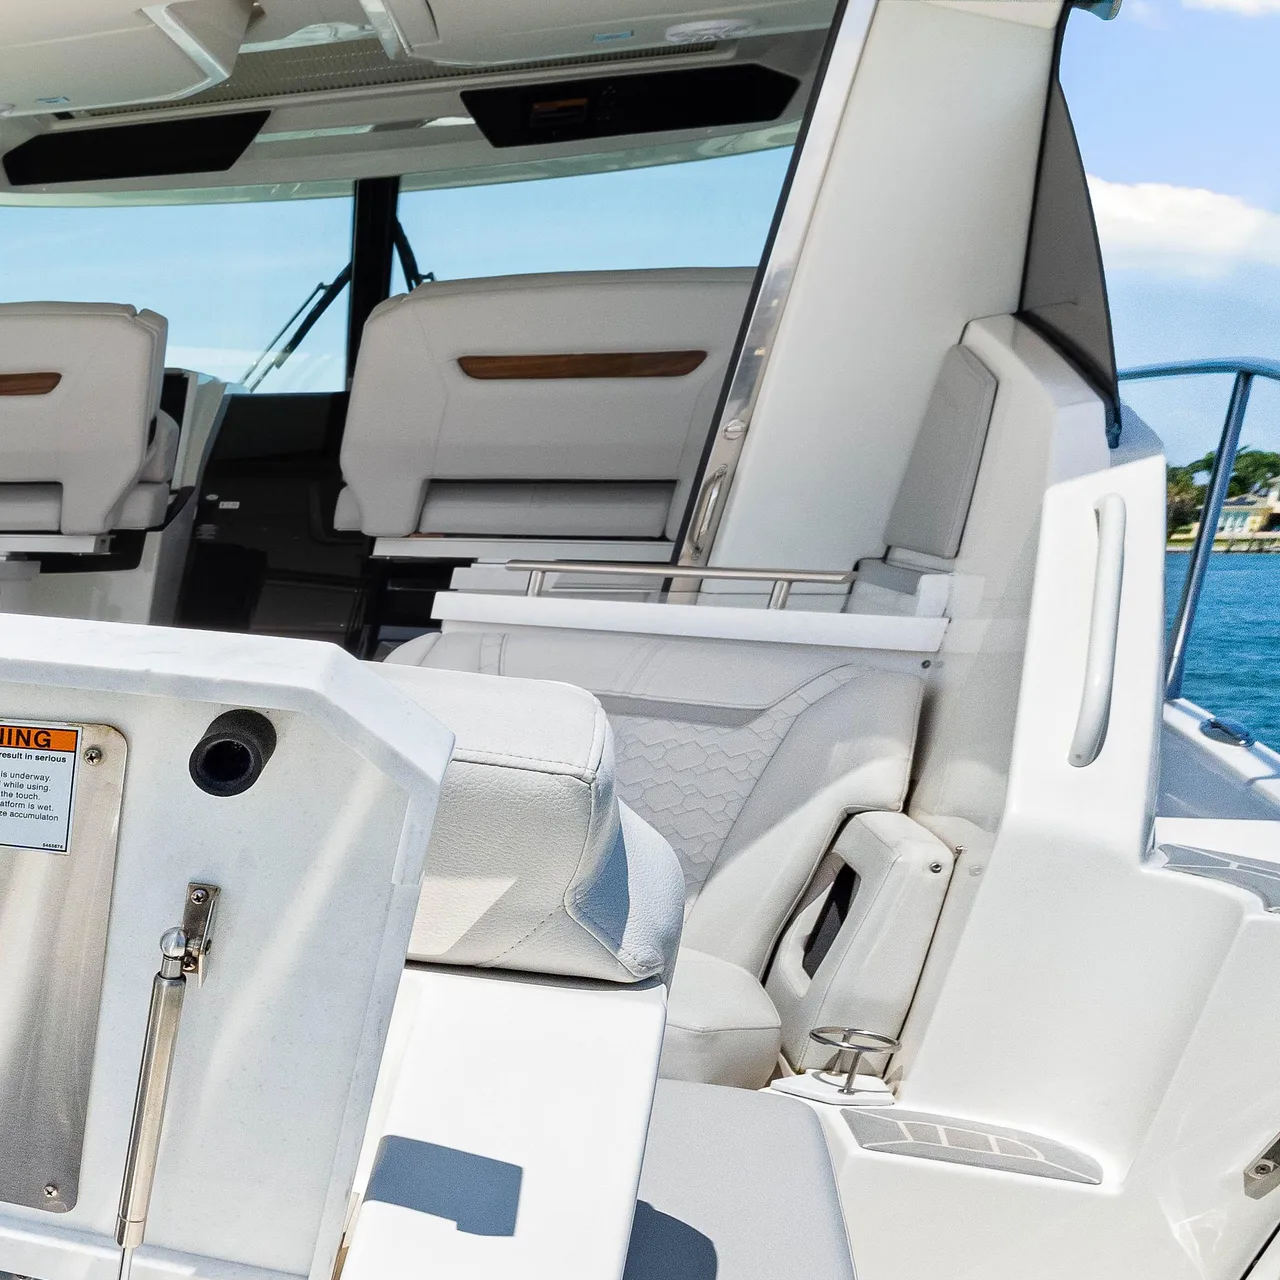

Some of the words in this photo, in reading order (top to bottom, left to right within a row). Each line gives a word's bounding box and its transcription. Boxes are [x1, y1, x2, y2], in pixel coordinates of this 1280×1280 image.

[10, 773, 51, 782] underway.
[27, 784, 51, 792] using.
[0, 790, 13, 798] the
[16, 792, 40, 800] touch.
